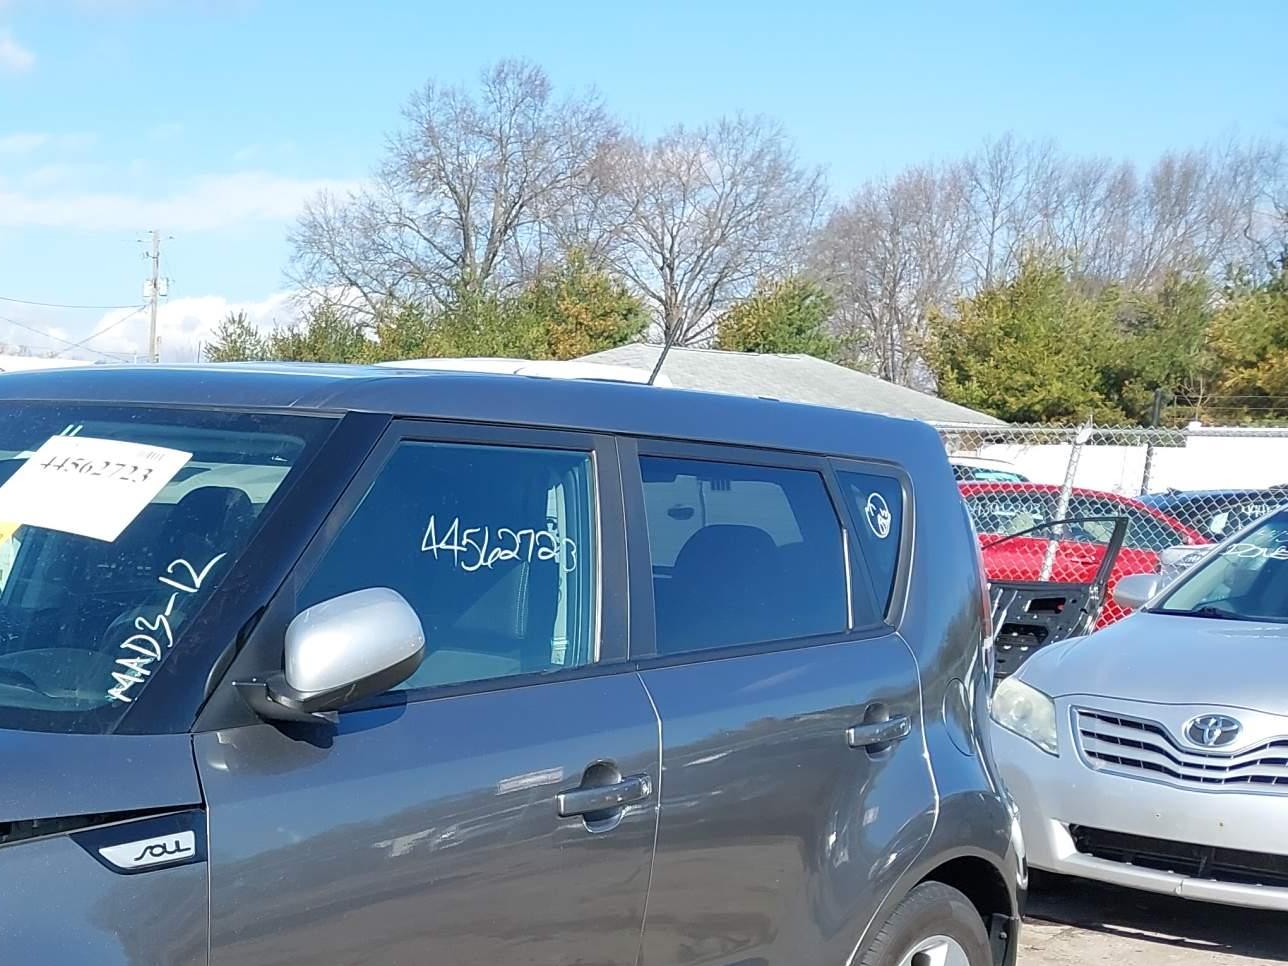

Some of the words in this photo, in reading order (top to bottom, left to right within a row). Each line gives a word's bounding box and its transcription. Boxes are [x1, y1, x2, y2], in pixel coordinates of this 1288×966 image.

[40, 455, 154, 482] 44562723
[420, 514, 578, 573] 44562723
[133, 839, 192, 862] SOUL
